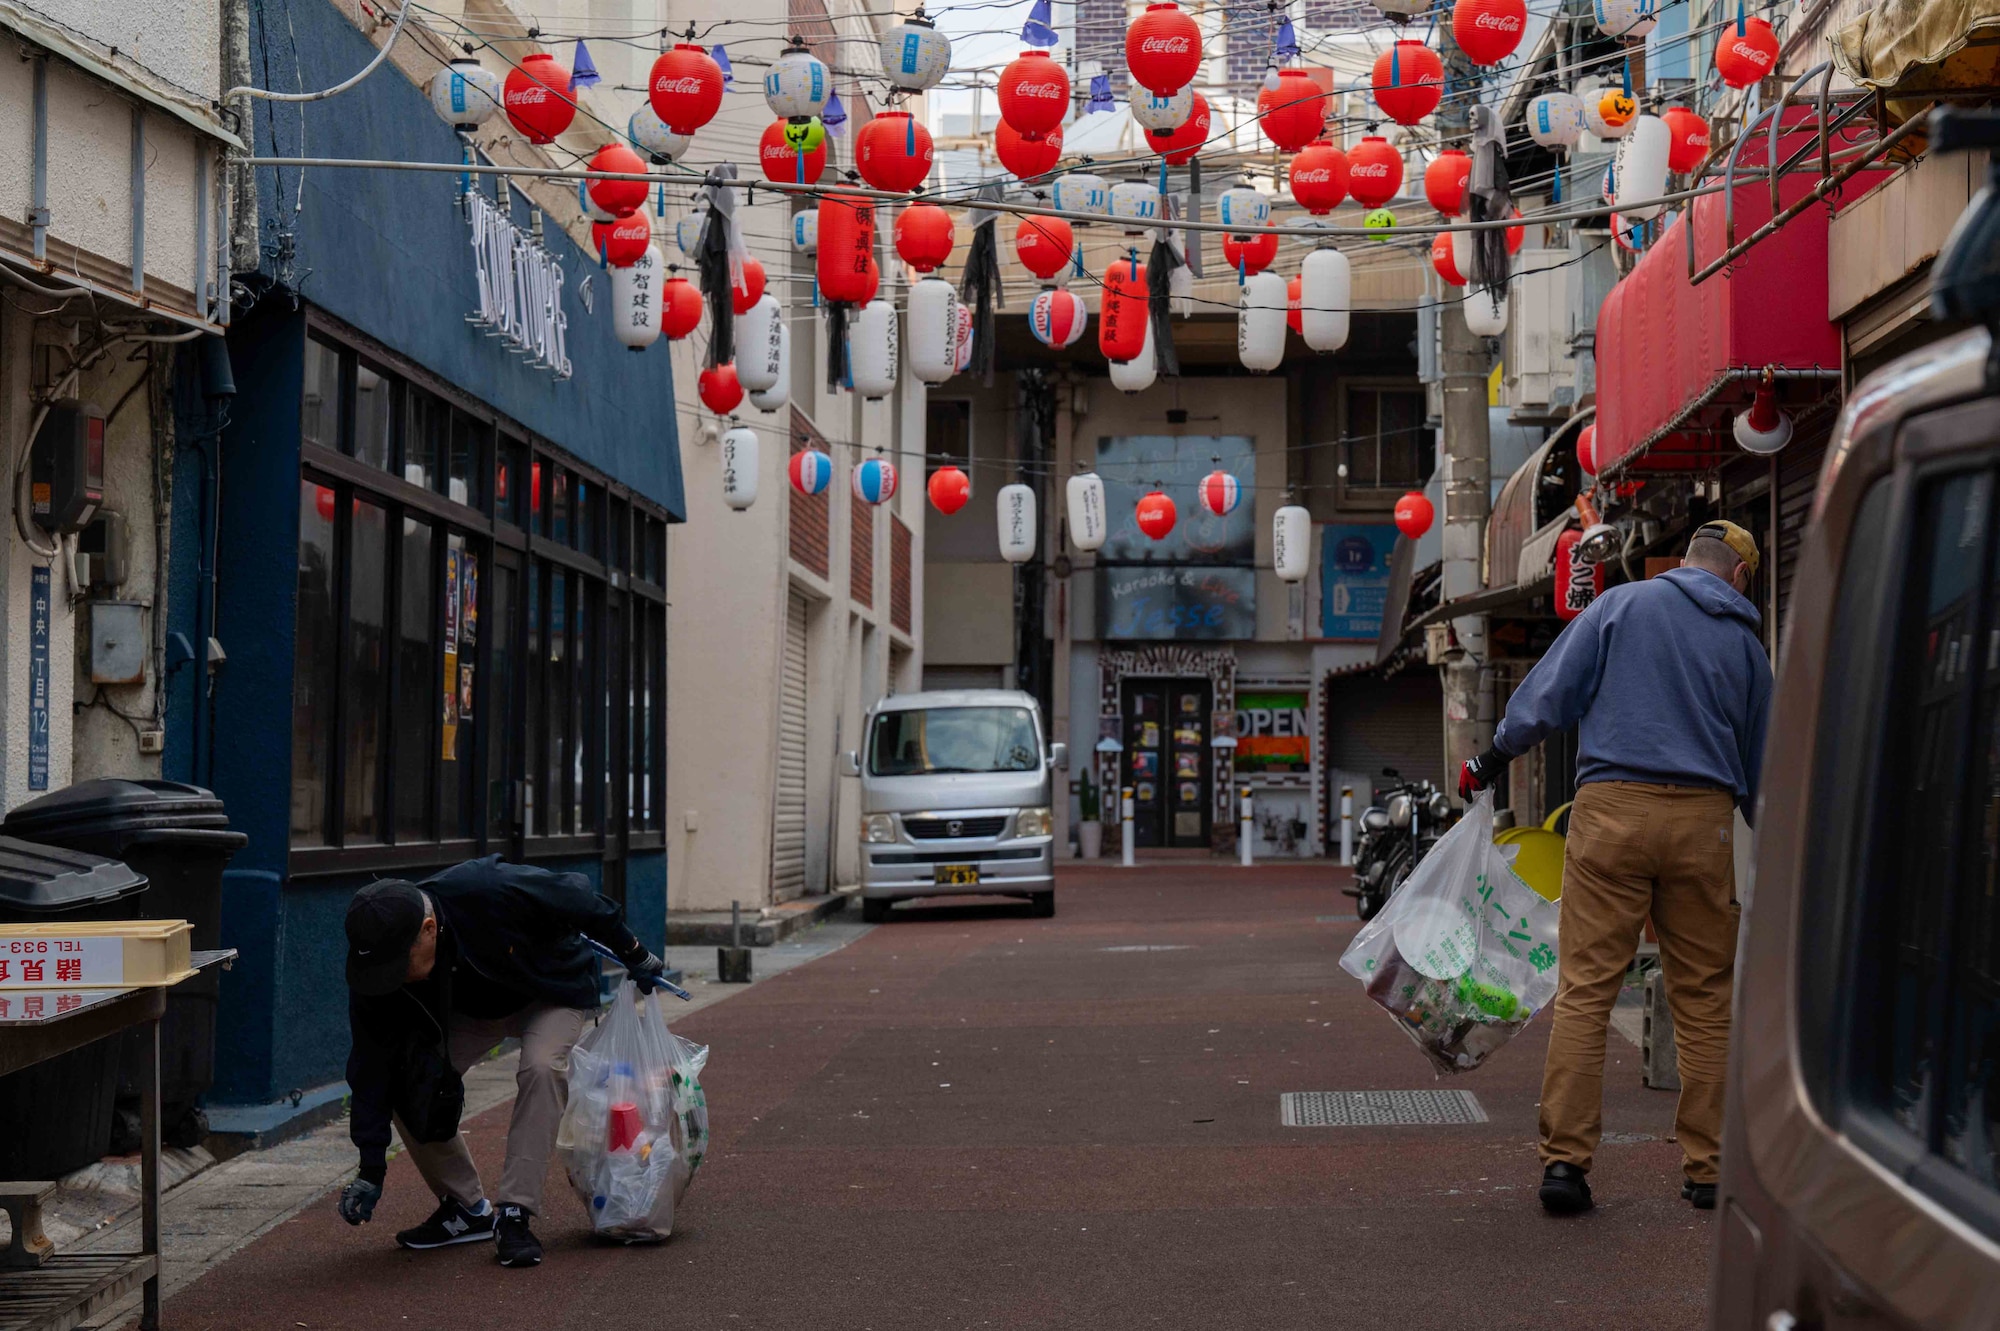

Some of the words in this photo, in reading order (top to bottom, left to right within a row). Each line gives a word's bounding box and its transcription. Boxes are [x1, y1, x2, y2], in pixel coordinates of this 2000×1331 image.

[1475, 12, 1519, 32] Coca-Cola
[1142, 36, 1191, 54] Coca-Cola
[1732, 41, 1771, 66] Coca-Cola
[656, 75, 701, 95] Coca-Cola
[1015, 80, 1061, 99] Coca-Cola
[506, 88, 547, 105] Coca-Cola
[1293, 168, 1331, 183] Coca-Cola
[1350, 163, 1388, 177] Coca-Cola
[1111, 572, 1176, 599] Karaoke
[1179, 571, 1195, 587] &
[1114, 597, 1226, 636] Jesse
[35, 597, 46, 697] 中央一丁目
[33, 710, 48, 733] 12
[1236, 708, 1310, 737] OPEN
[54, 941, 84, 952] TEL
